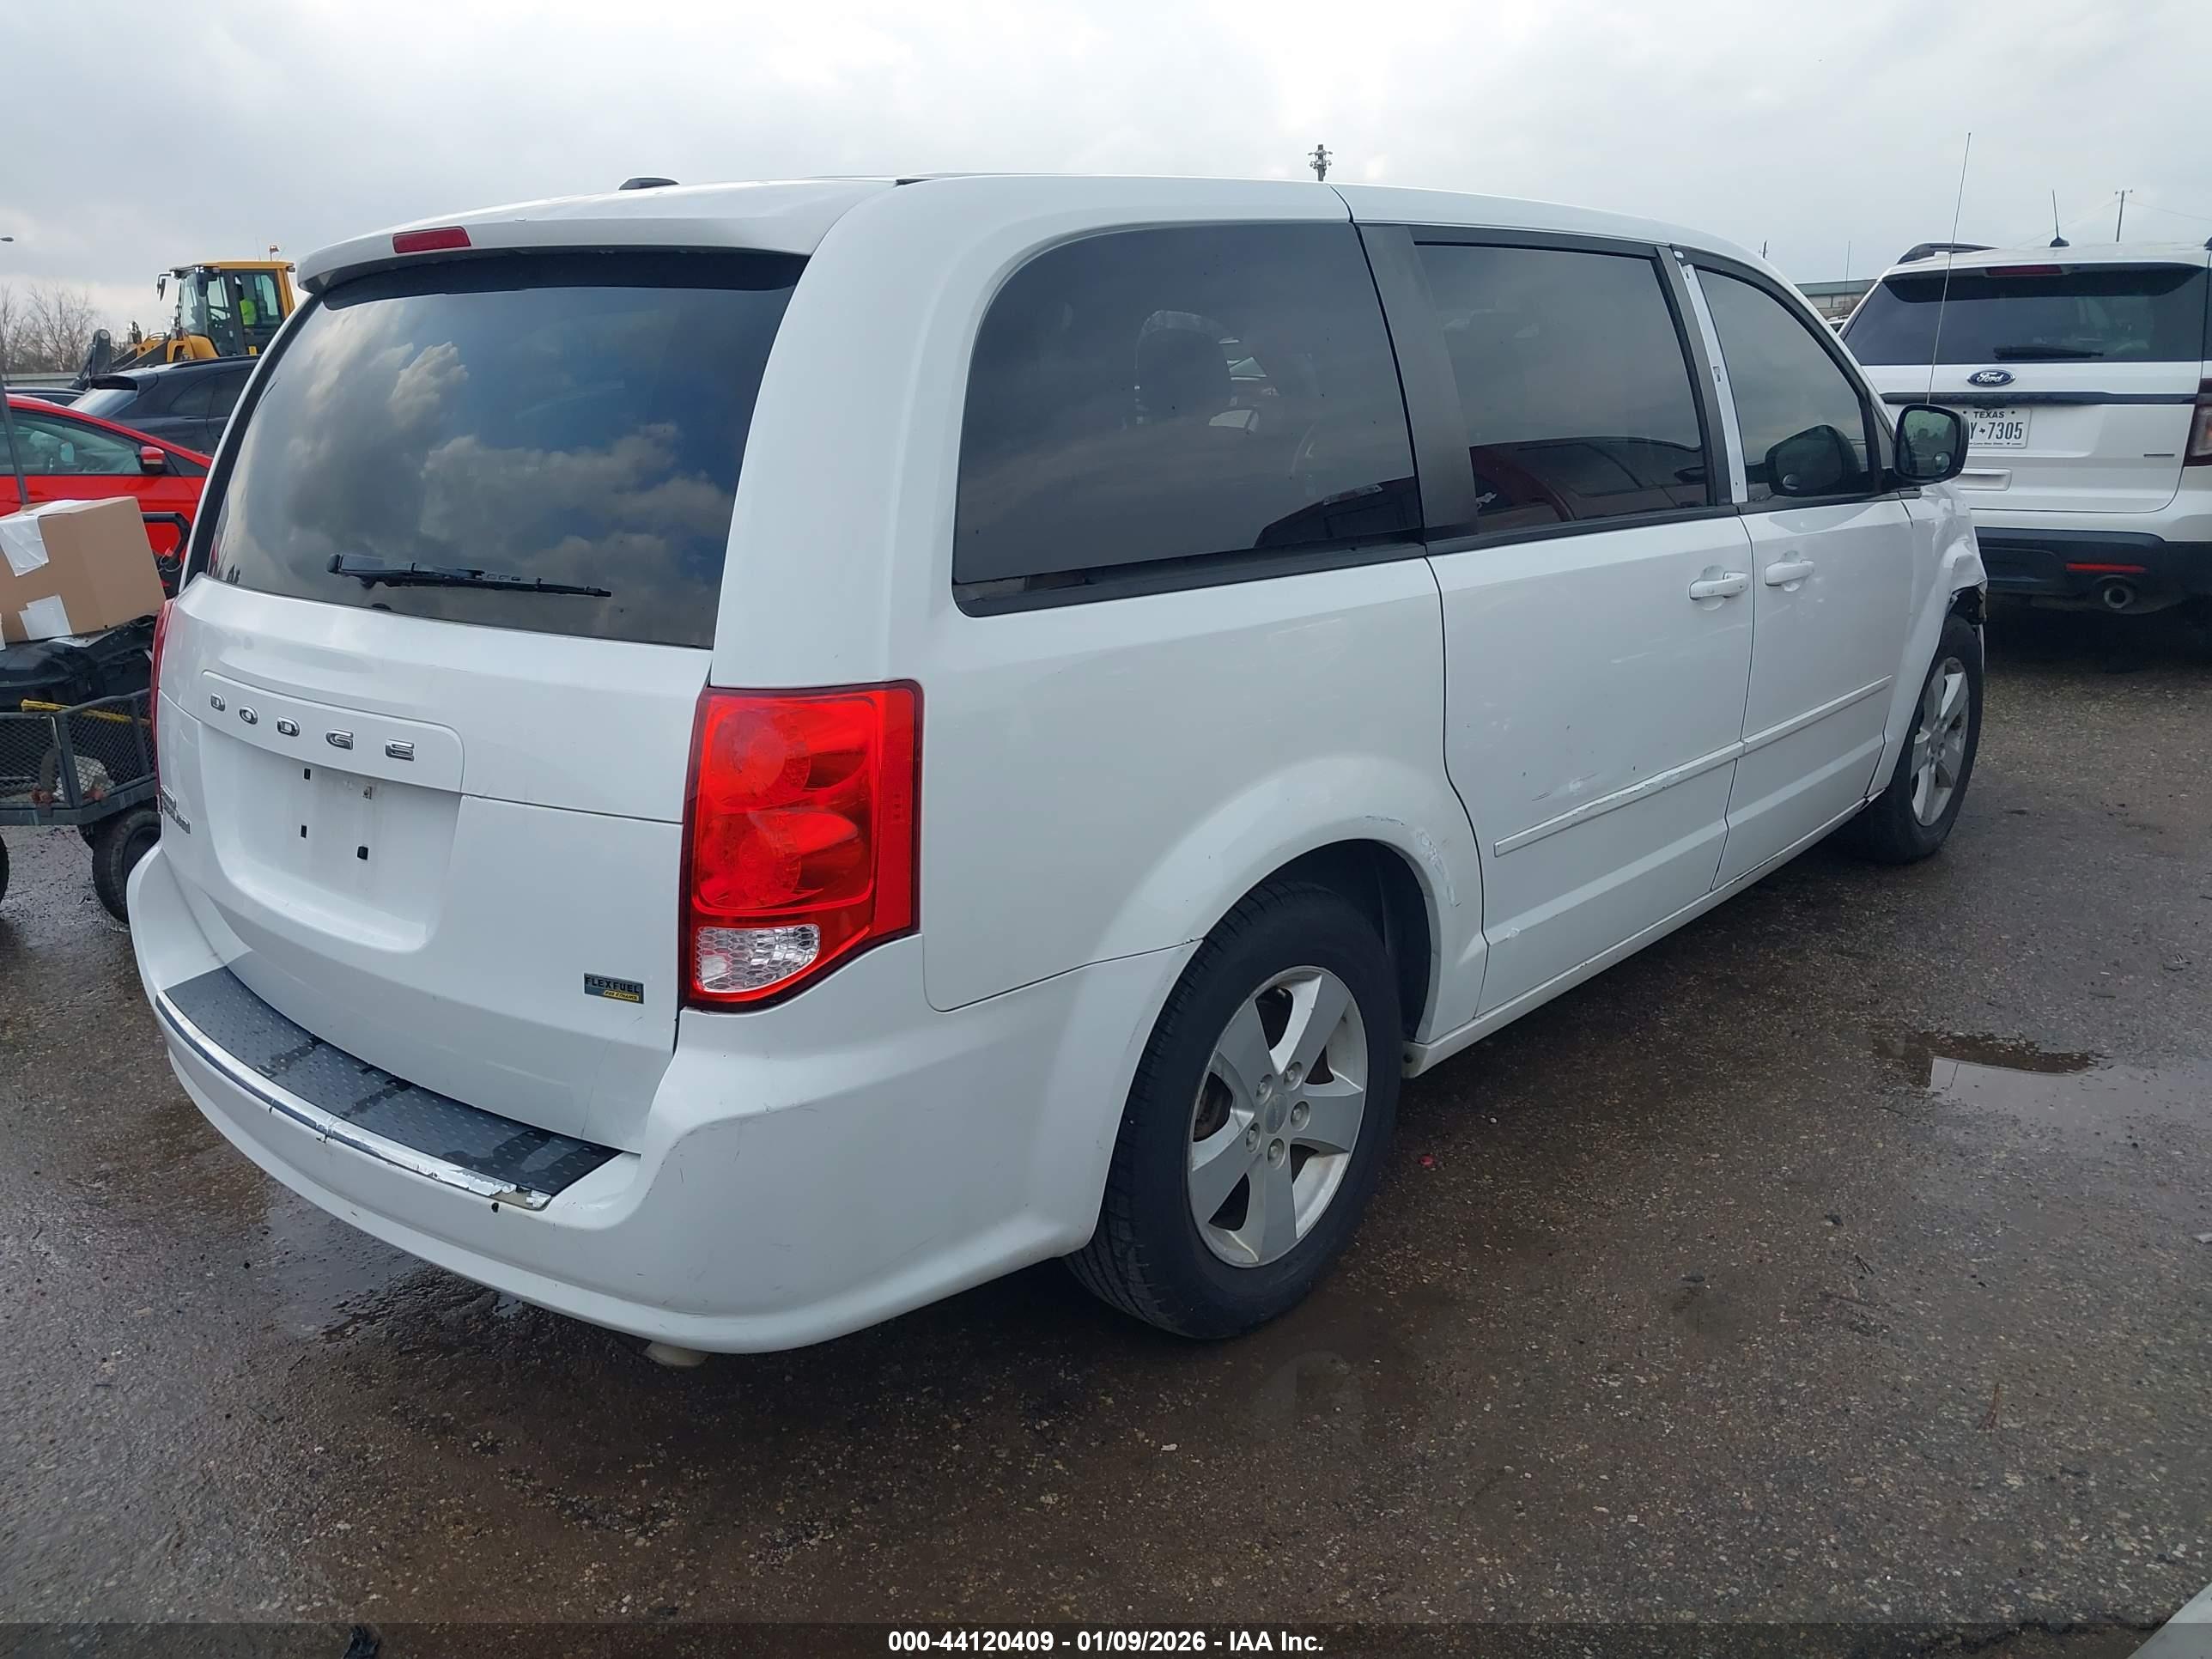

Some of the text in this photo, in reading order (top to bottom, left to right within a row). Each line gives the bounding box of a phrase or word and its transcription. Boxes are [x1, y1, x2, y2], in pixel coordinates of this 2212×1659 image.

[1976, 371, 2004, 383] Ford
[1973, 410, 2005, 419] TEXAS
[210, 693, 415, 762] DODGE
